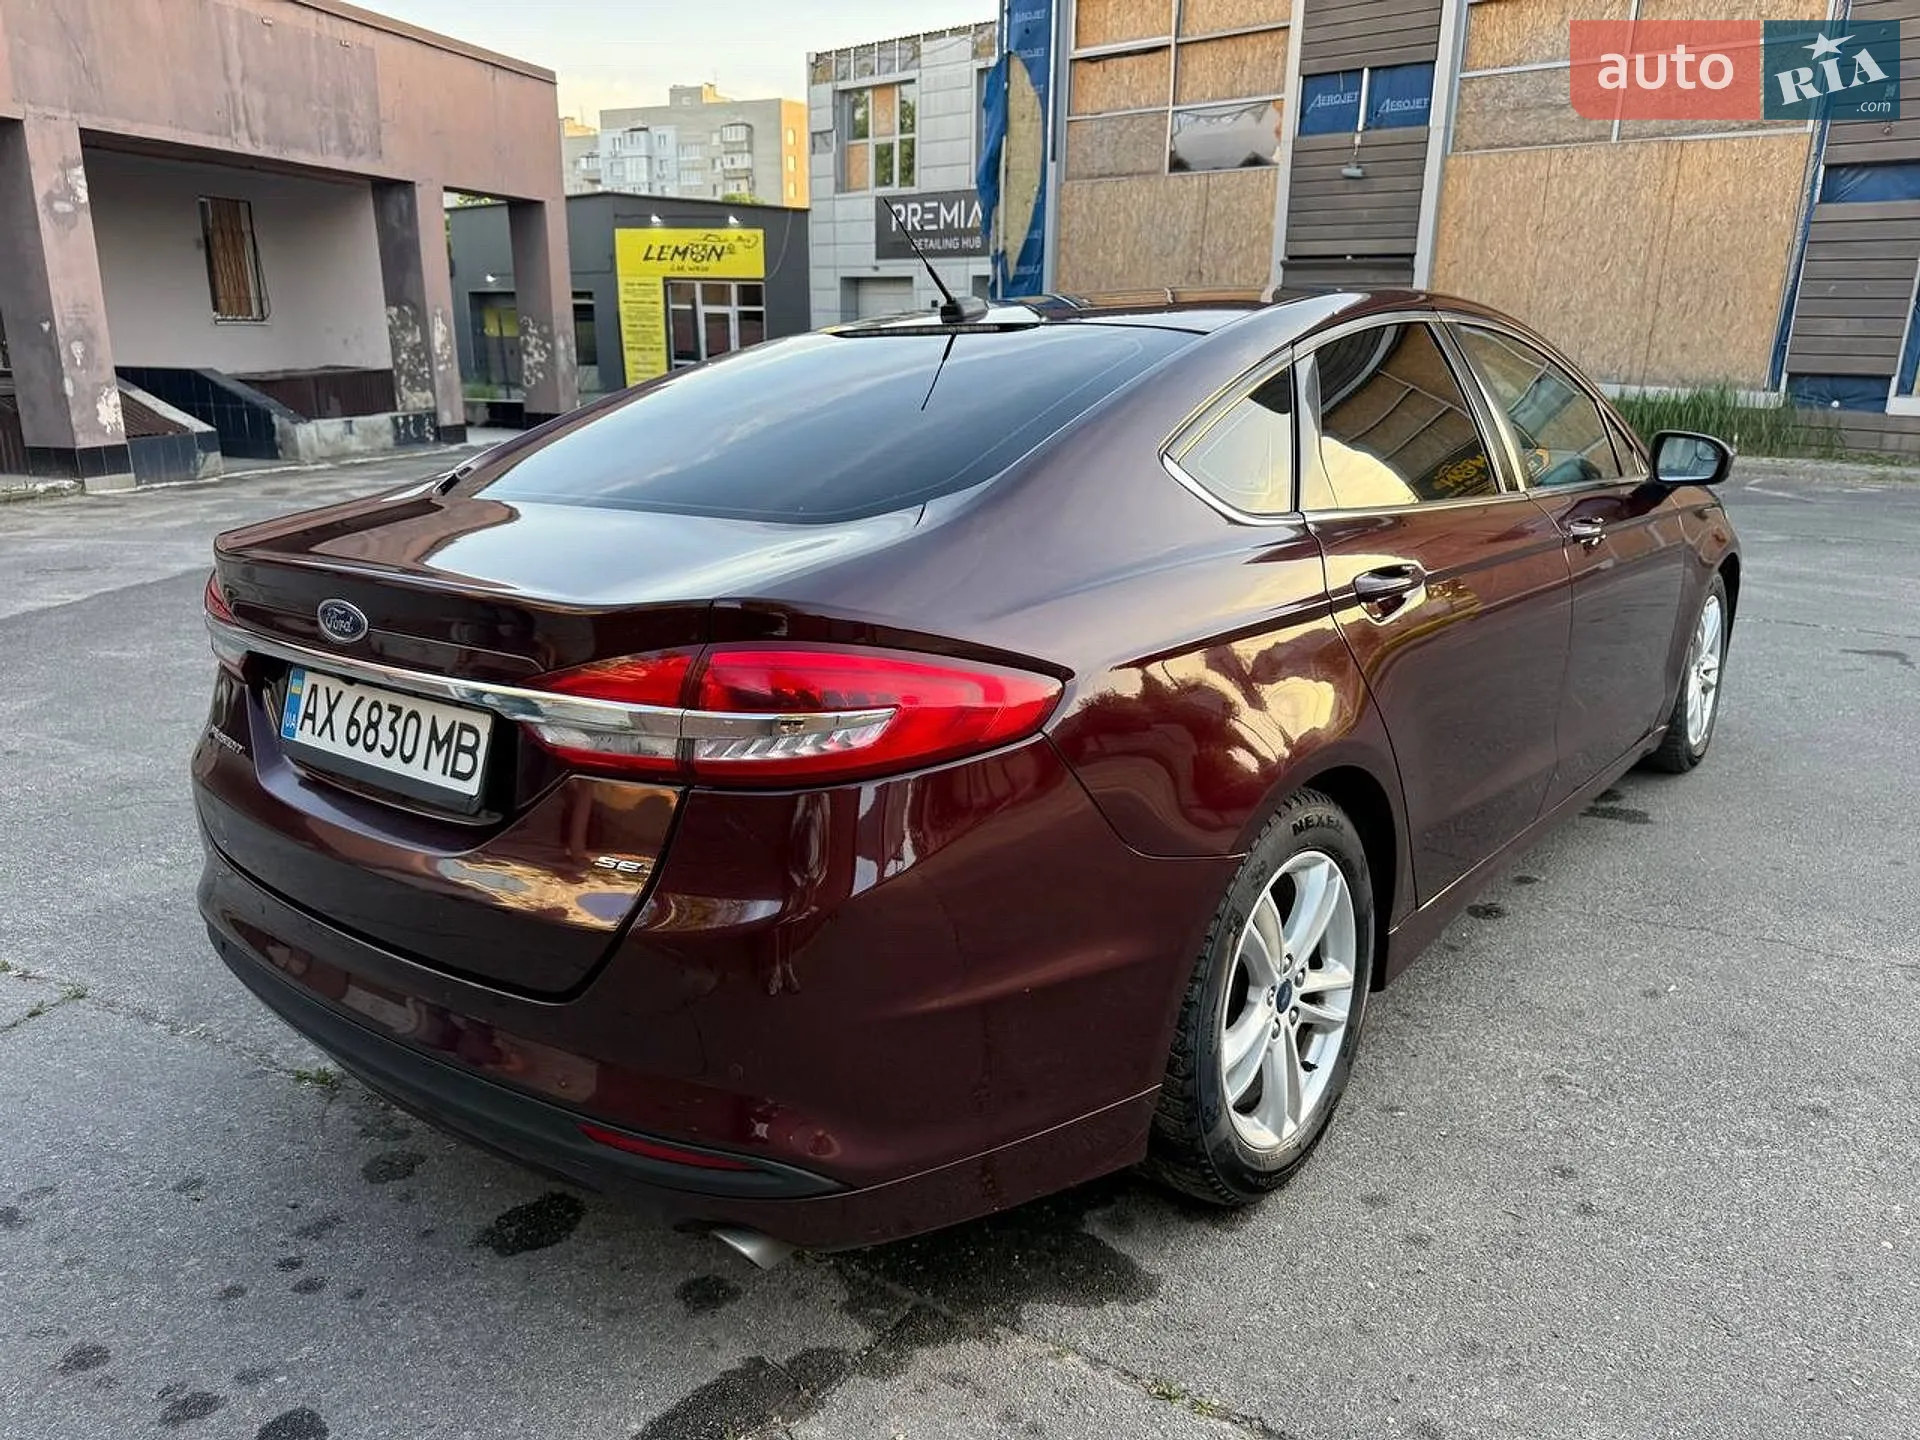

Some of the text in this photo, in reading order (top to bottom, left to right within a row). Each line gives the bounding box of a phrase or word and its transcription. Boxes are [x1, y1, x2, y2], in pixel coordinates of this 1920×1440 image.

[961, 235, 982, 249] HUB
[643, 243, 725, 263] LEMON
[325, 606, 355, 633] Ford
[299, 682, 344, 743] AX
[344, 695, 422, 765] 6830
[422, 714, 481, 782] MB
[594, 856, 643, 873] SE
